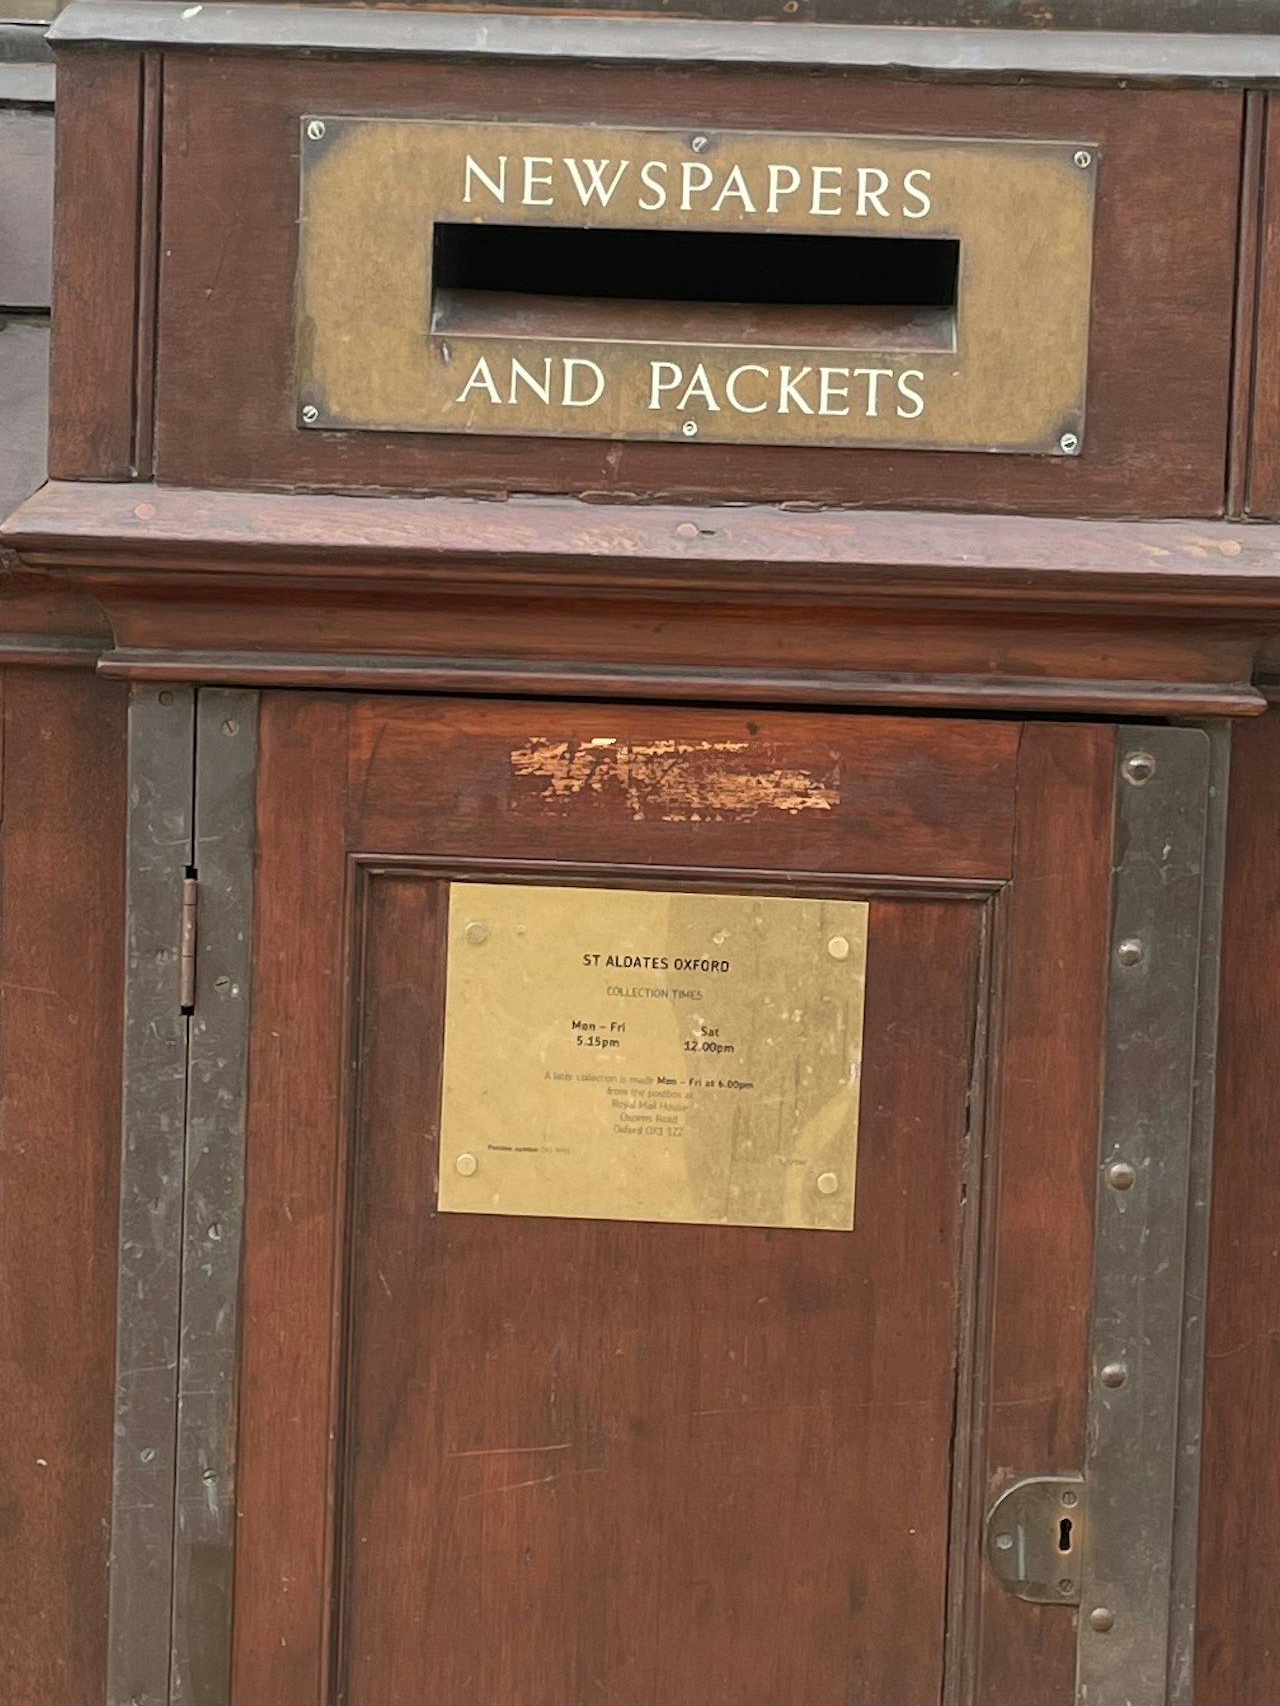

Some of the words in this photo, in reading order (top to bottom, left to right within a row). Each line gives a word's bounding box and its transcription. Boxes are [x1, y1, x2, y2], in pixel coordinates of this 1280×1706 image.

[461, 154, 934, 219] NEWSPAPERS
[456, 356, 607, 407] AND
[648, 360, 926, 419] PACKETS
[582, 953, 601, 966] ST
[606, 955, 669, 970] ALDATES
[674, 958, 730, 973] OXFORD
[606, 986, 669, 999] COLLECTION
[672, 989, 703, 1001] TIMES
[571, 1020, 596, 1032] Mon
[610, 1021, 626, 1033] Fri
[700, 1025, 719, 1038] Sat
[576, 1035, 620, 1048] 5.15pm
[683, 1041, 735, 1054] 12.00pm
[544, 1071, 551, 1080] A
[689, 1077, 702, 1087] Fri
[705, 1079, 714, 1088] at
[639, 1100, 657, 1110] Mail
